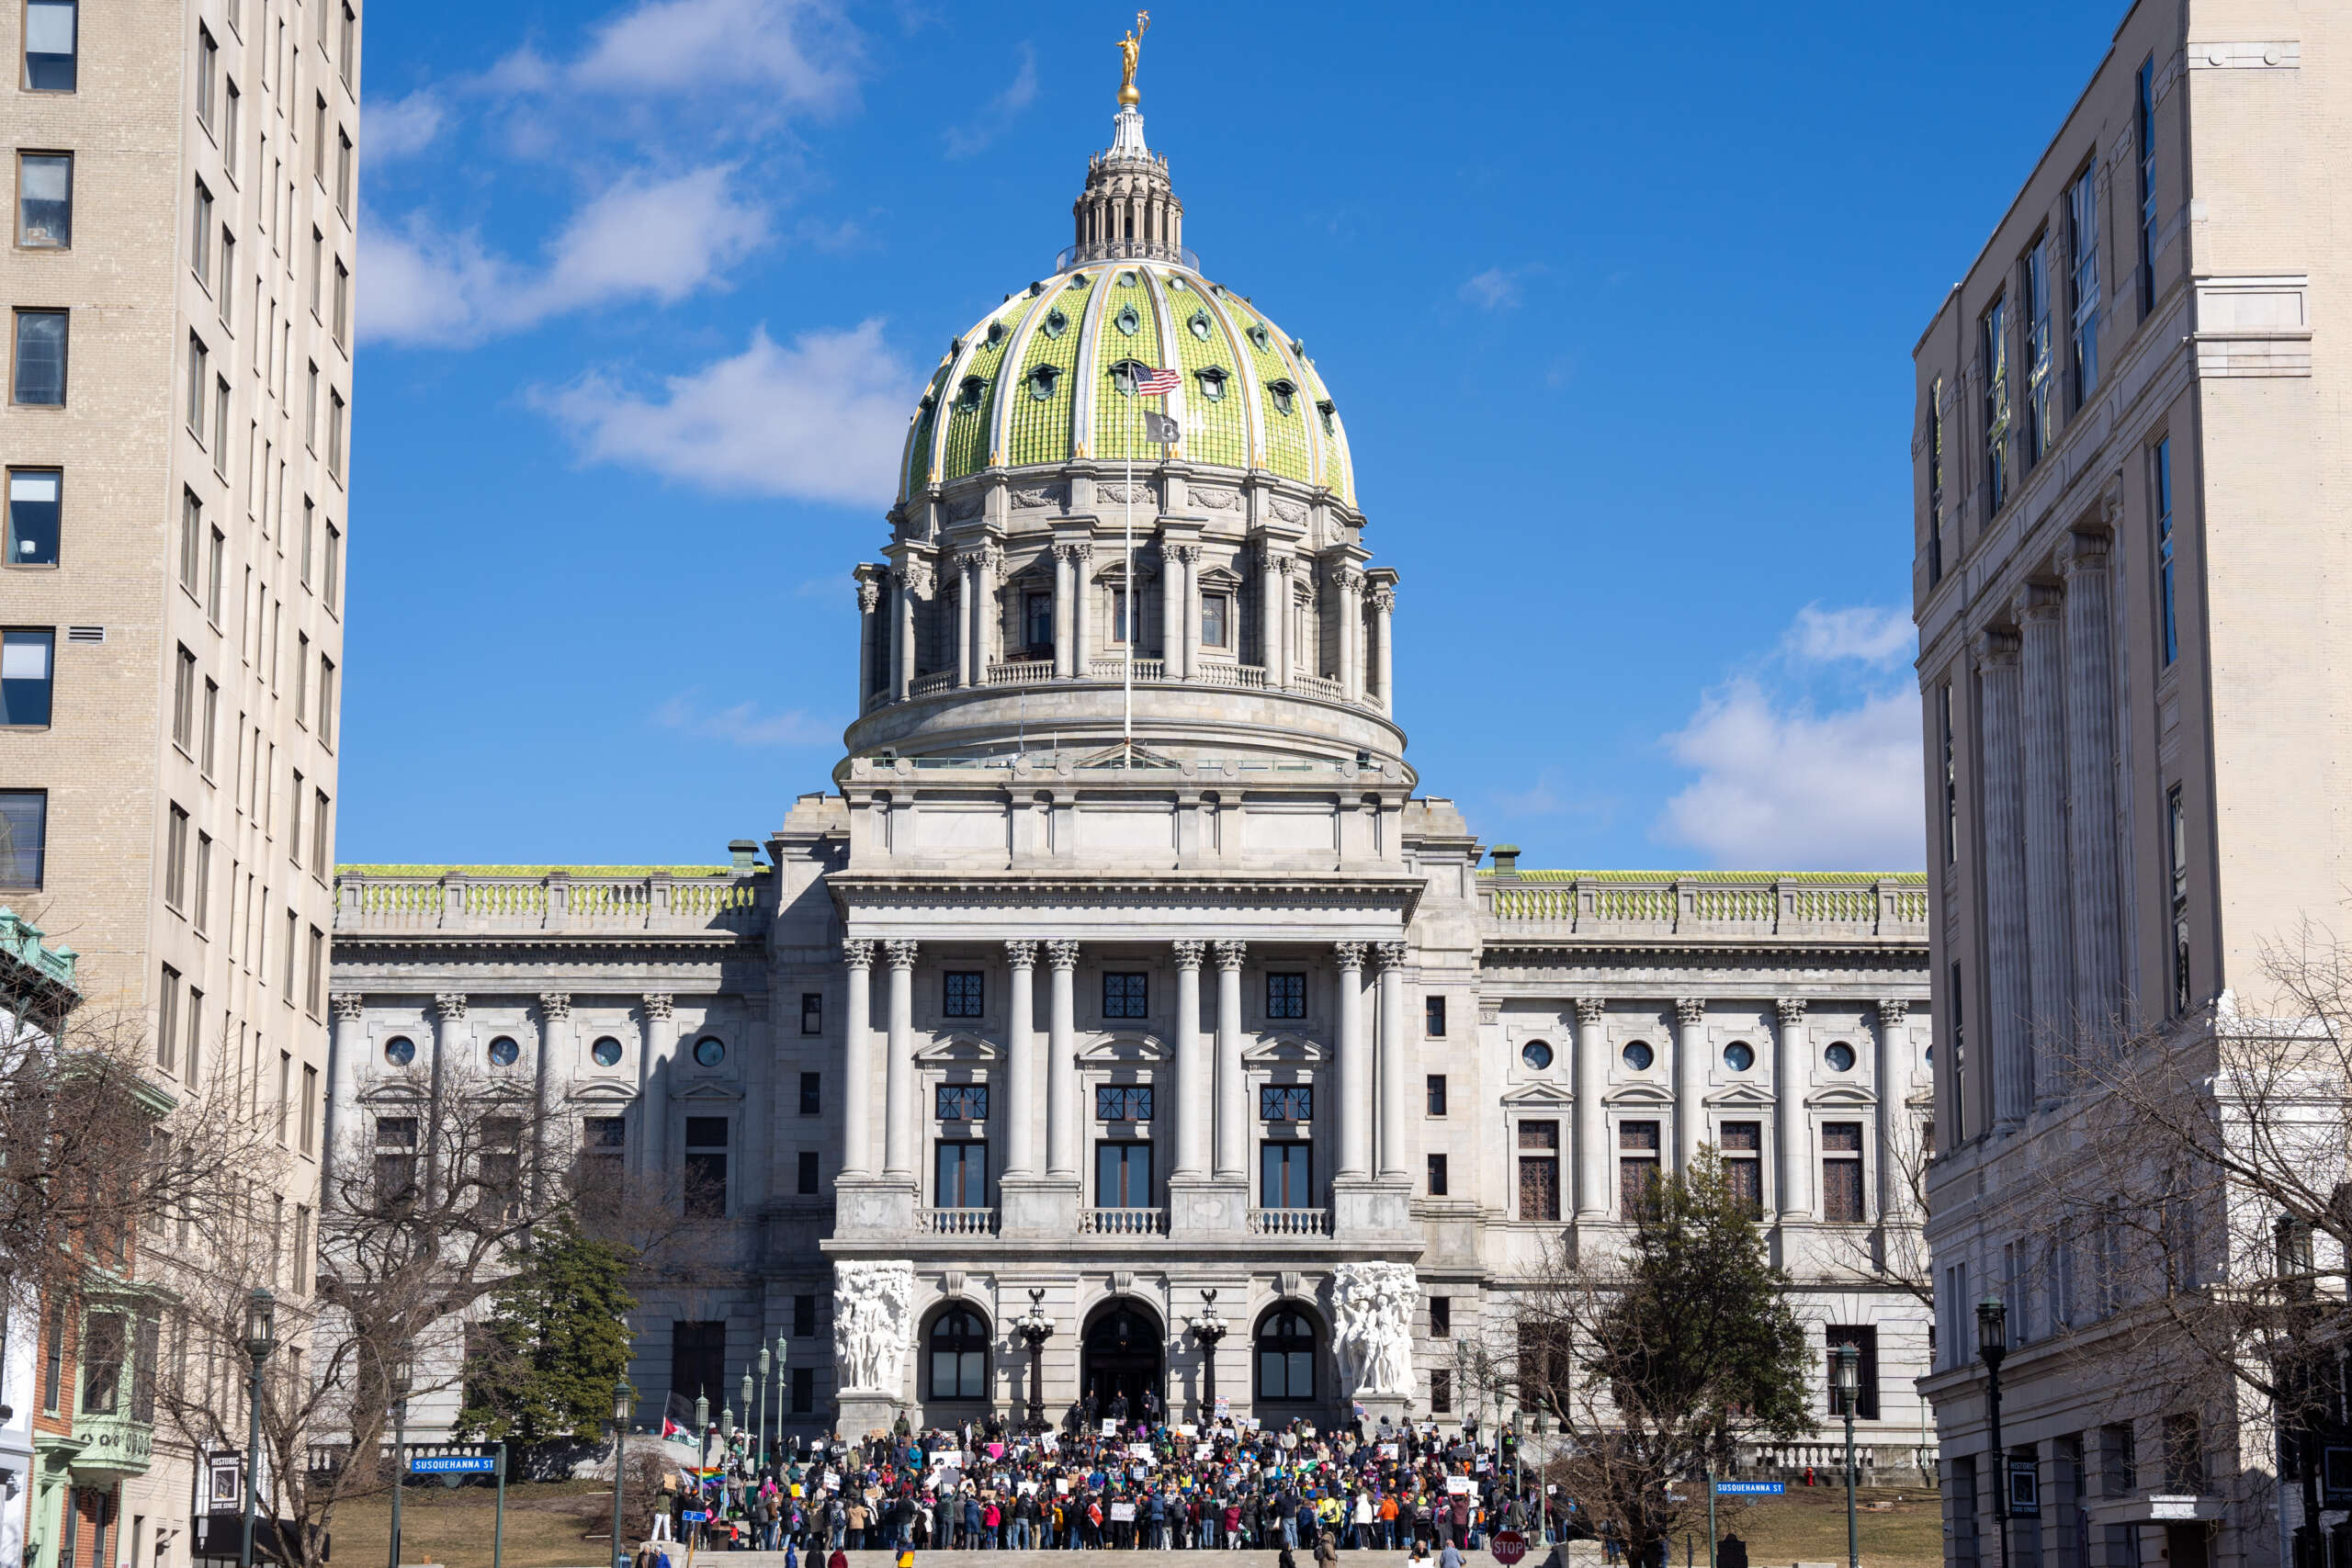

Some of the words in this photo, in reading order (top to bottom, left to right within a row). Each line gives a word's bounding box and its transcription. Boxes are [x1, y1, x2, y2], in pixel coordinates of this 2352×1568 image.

[211, 1457, 240, 1466] HISTORIC
[415, 1460, 480, 1470] SUSQUEHANNA
[483, 1460, 494, 1469] ST
[2010, 1461, 2037, 1470] HISTORIC
[1717, 1483, 1770, 1492] SUSQUEHANNA
[1772, 1484, 1781, 1493] ST
[1494, 1541, 1523, 1555] STOP
